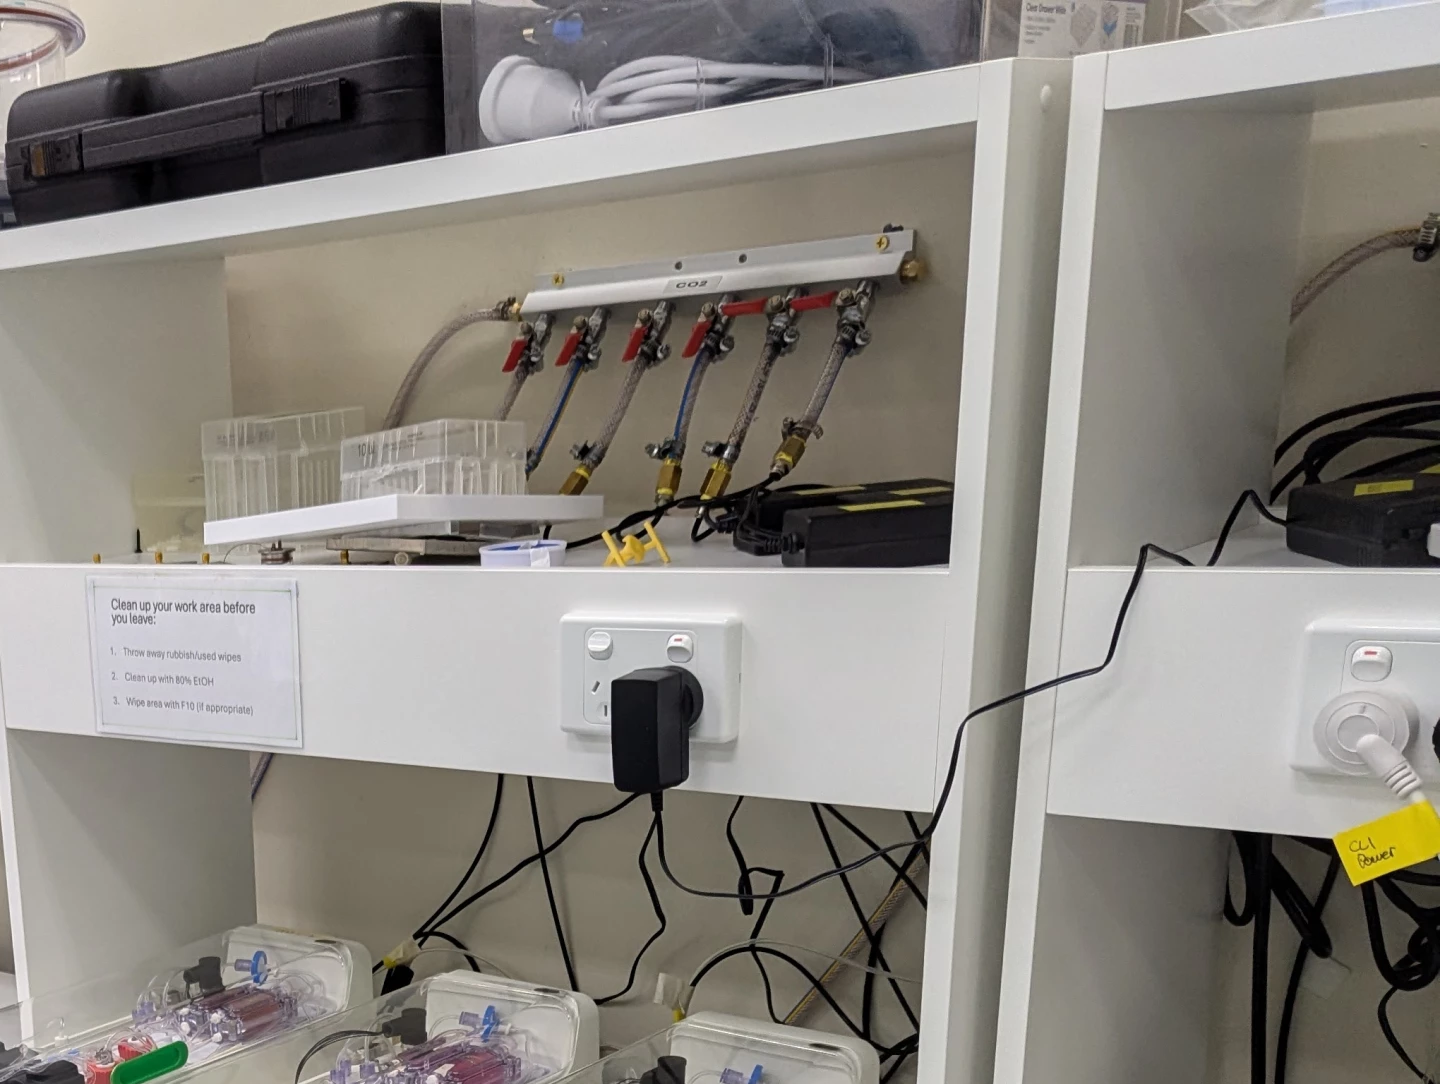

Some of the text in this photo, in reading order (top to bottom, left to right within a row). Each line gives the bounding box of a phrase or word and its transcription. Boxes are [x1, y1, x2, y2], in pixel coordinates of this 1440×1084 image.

[676, 280, 708, 289] CO2
[111, 598, 256, 614] Clean up your work area before
[112, 613, 156, 626] you leave:
[110, 647, 241, 663] 1. Throw away rubbish/used wipes
[112, 672, 118, 681] 2.
[124, 673, 146, 682] Clean
[147, 675, 157, 684] up
[158, 675, 174, 684] with
[175, 676, 192, 685] 80%
[113, 697, 120, 705] 3.
[126, 697, 145, 708] Wipe
[147, 700, 163, 708] area
[164, 700, 180, 709] with
[205, 705, 254, 716] appropriate)
